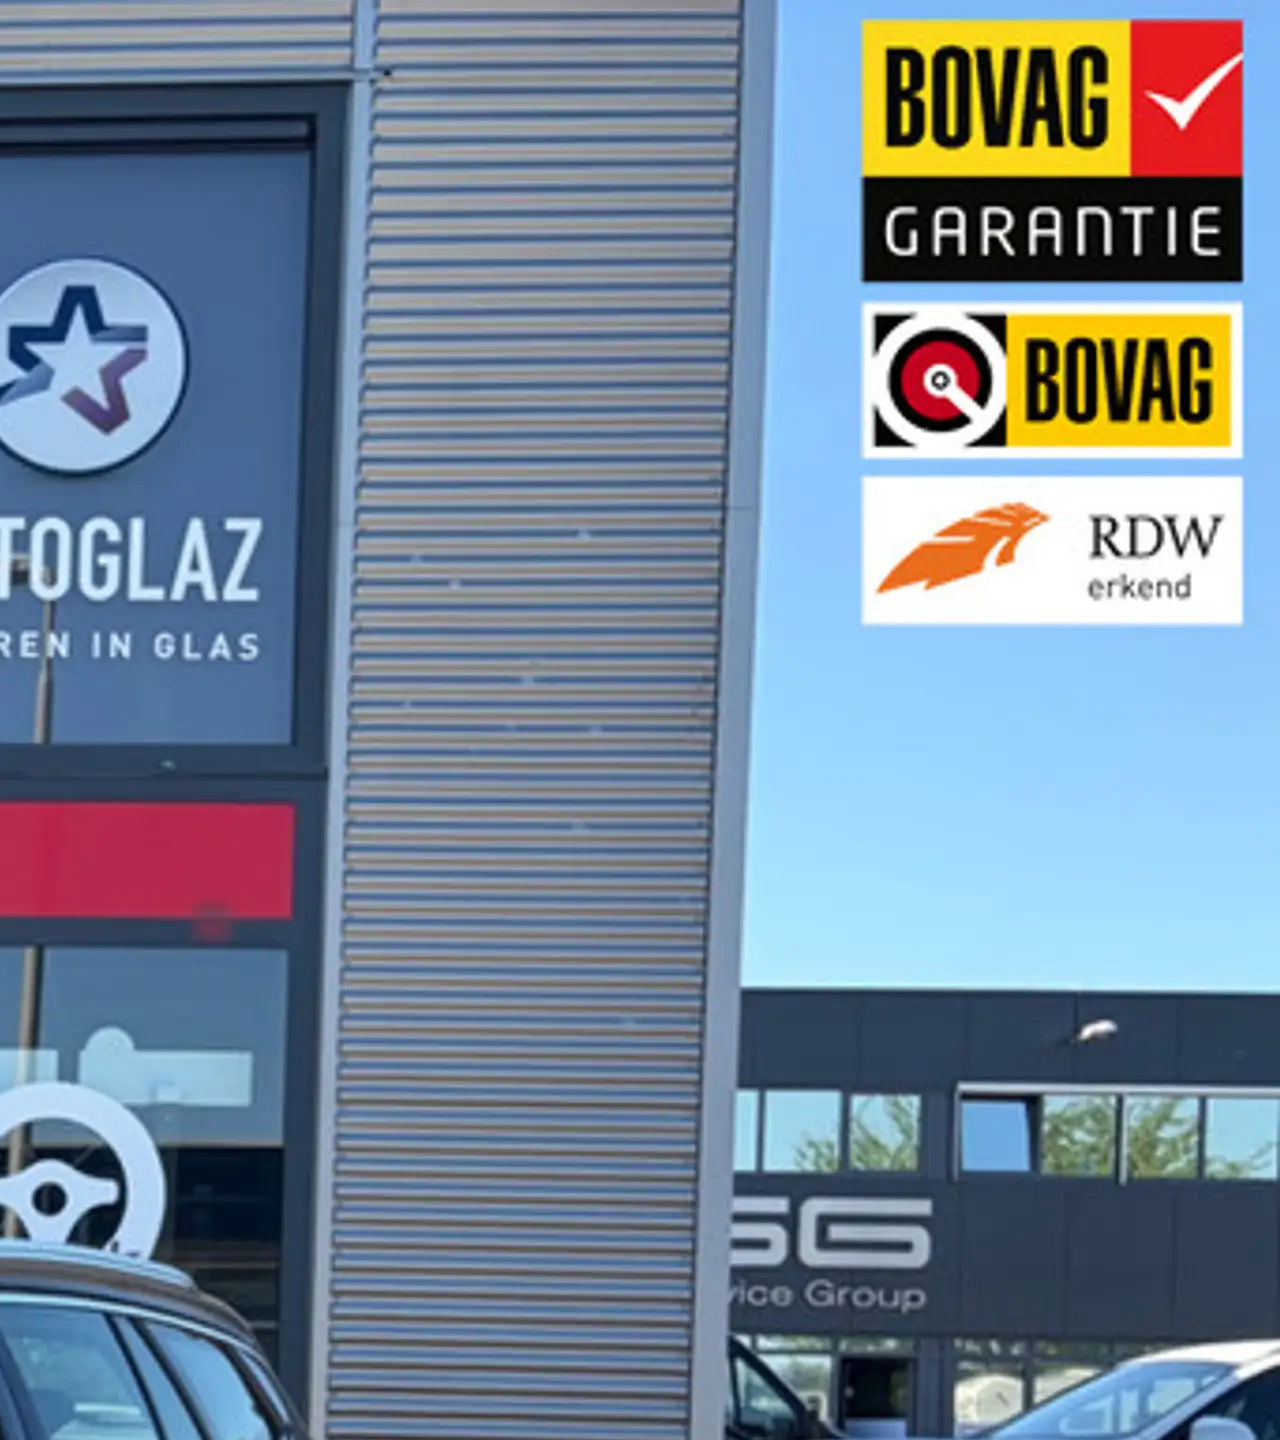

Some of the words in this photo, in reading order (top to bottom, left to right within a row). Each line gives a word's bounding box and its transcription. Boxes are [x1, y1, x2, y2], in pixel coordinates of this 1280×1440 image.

[92, 631, 132, 660] IN
[154, 632, 261, 662] GLAS
[805, 1279, 928, 1313] Group
